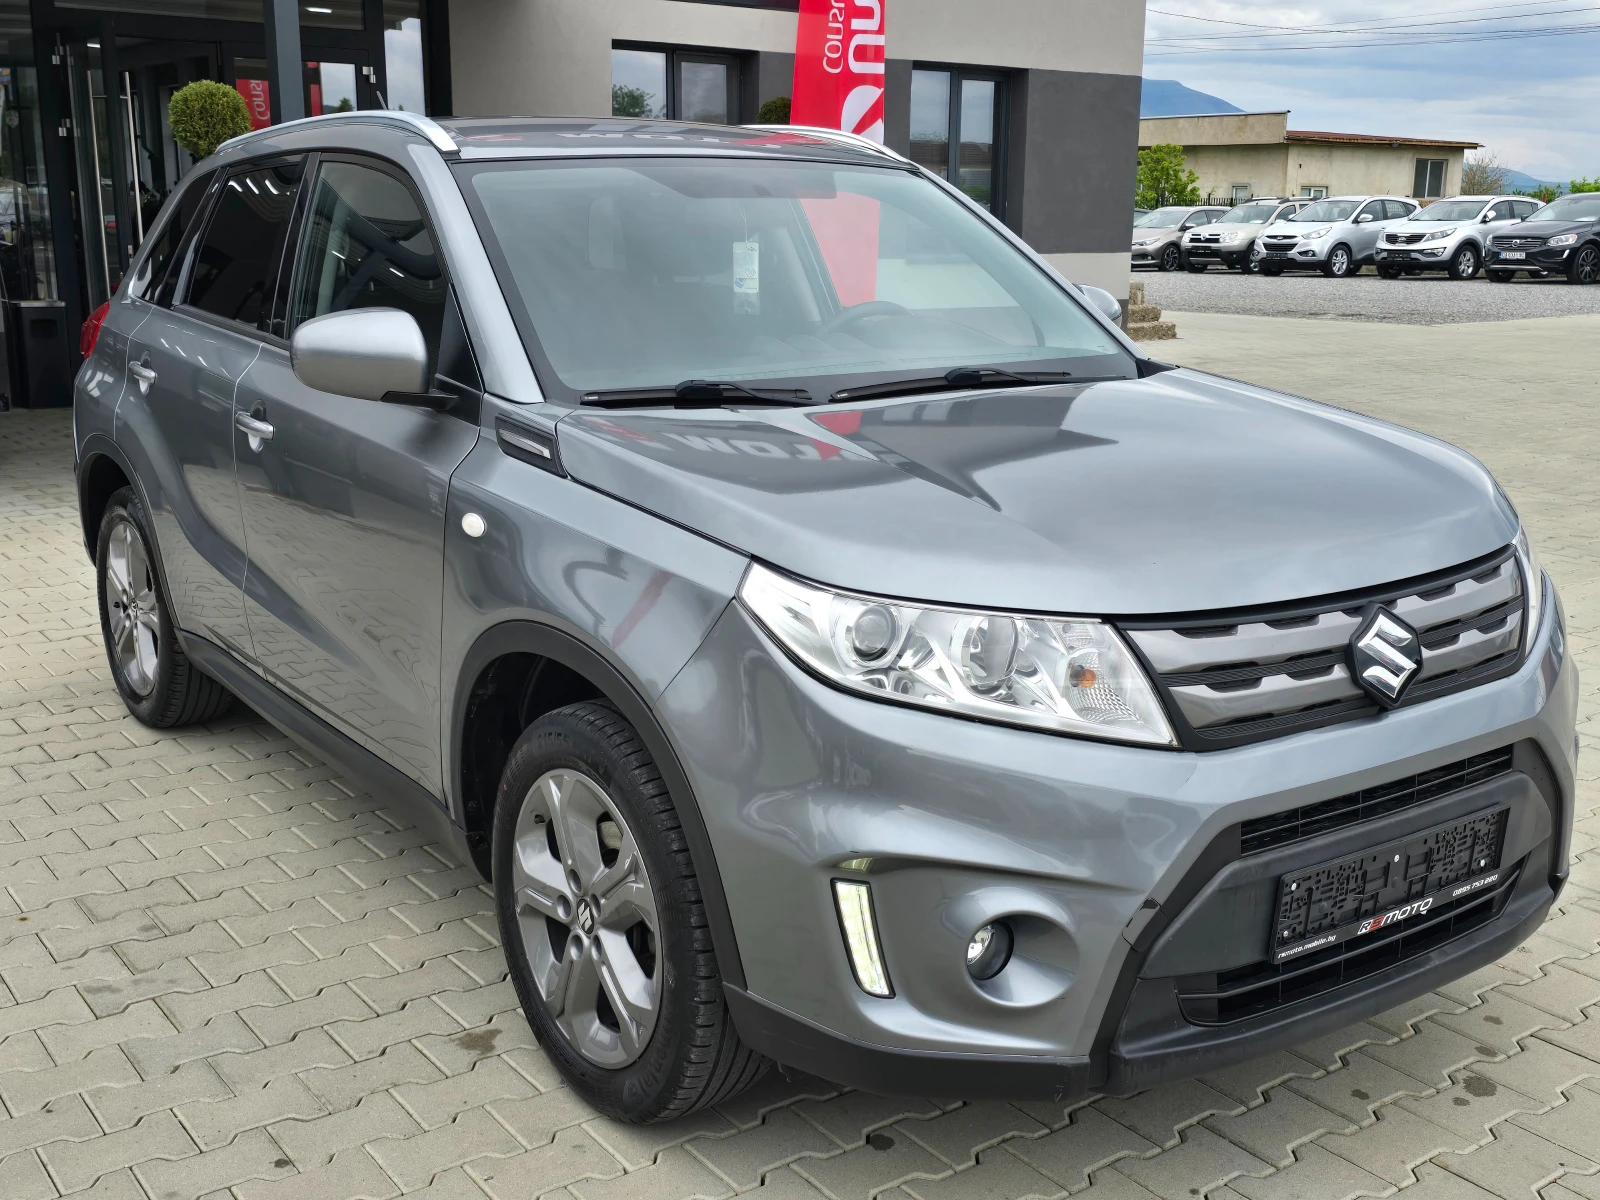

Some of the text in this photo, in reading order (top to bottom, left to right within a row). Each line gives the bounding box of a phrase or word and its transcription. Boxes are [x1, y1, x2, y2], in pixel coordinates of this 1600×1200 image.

[1471, 879, 1484, 890] 753
[1357, 898, 1433, 934] RSMOTO
[1277, 934, 1337, 959] rsmoto.mobile.bg
